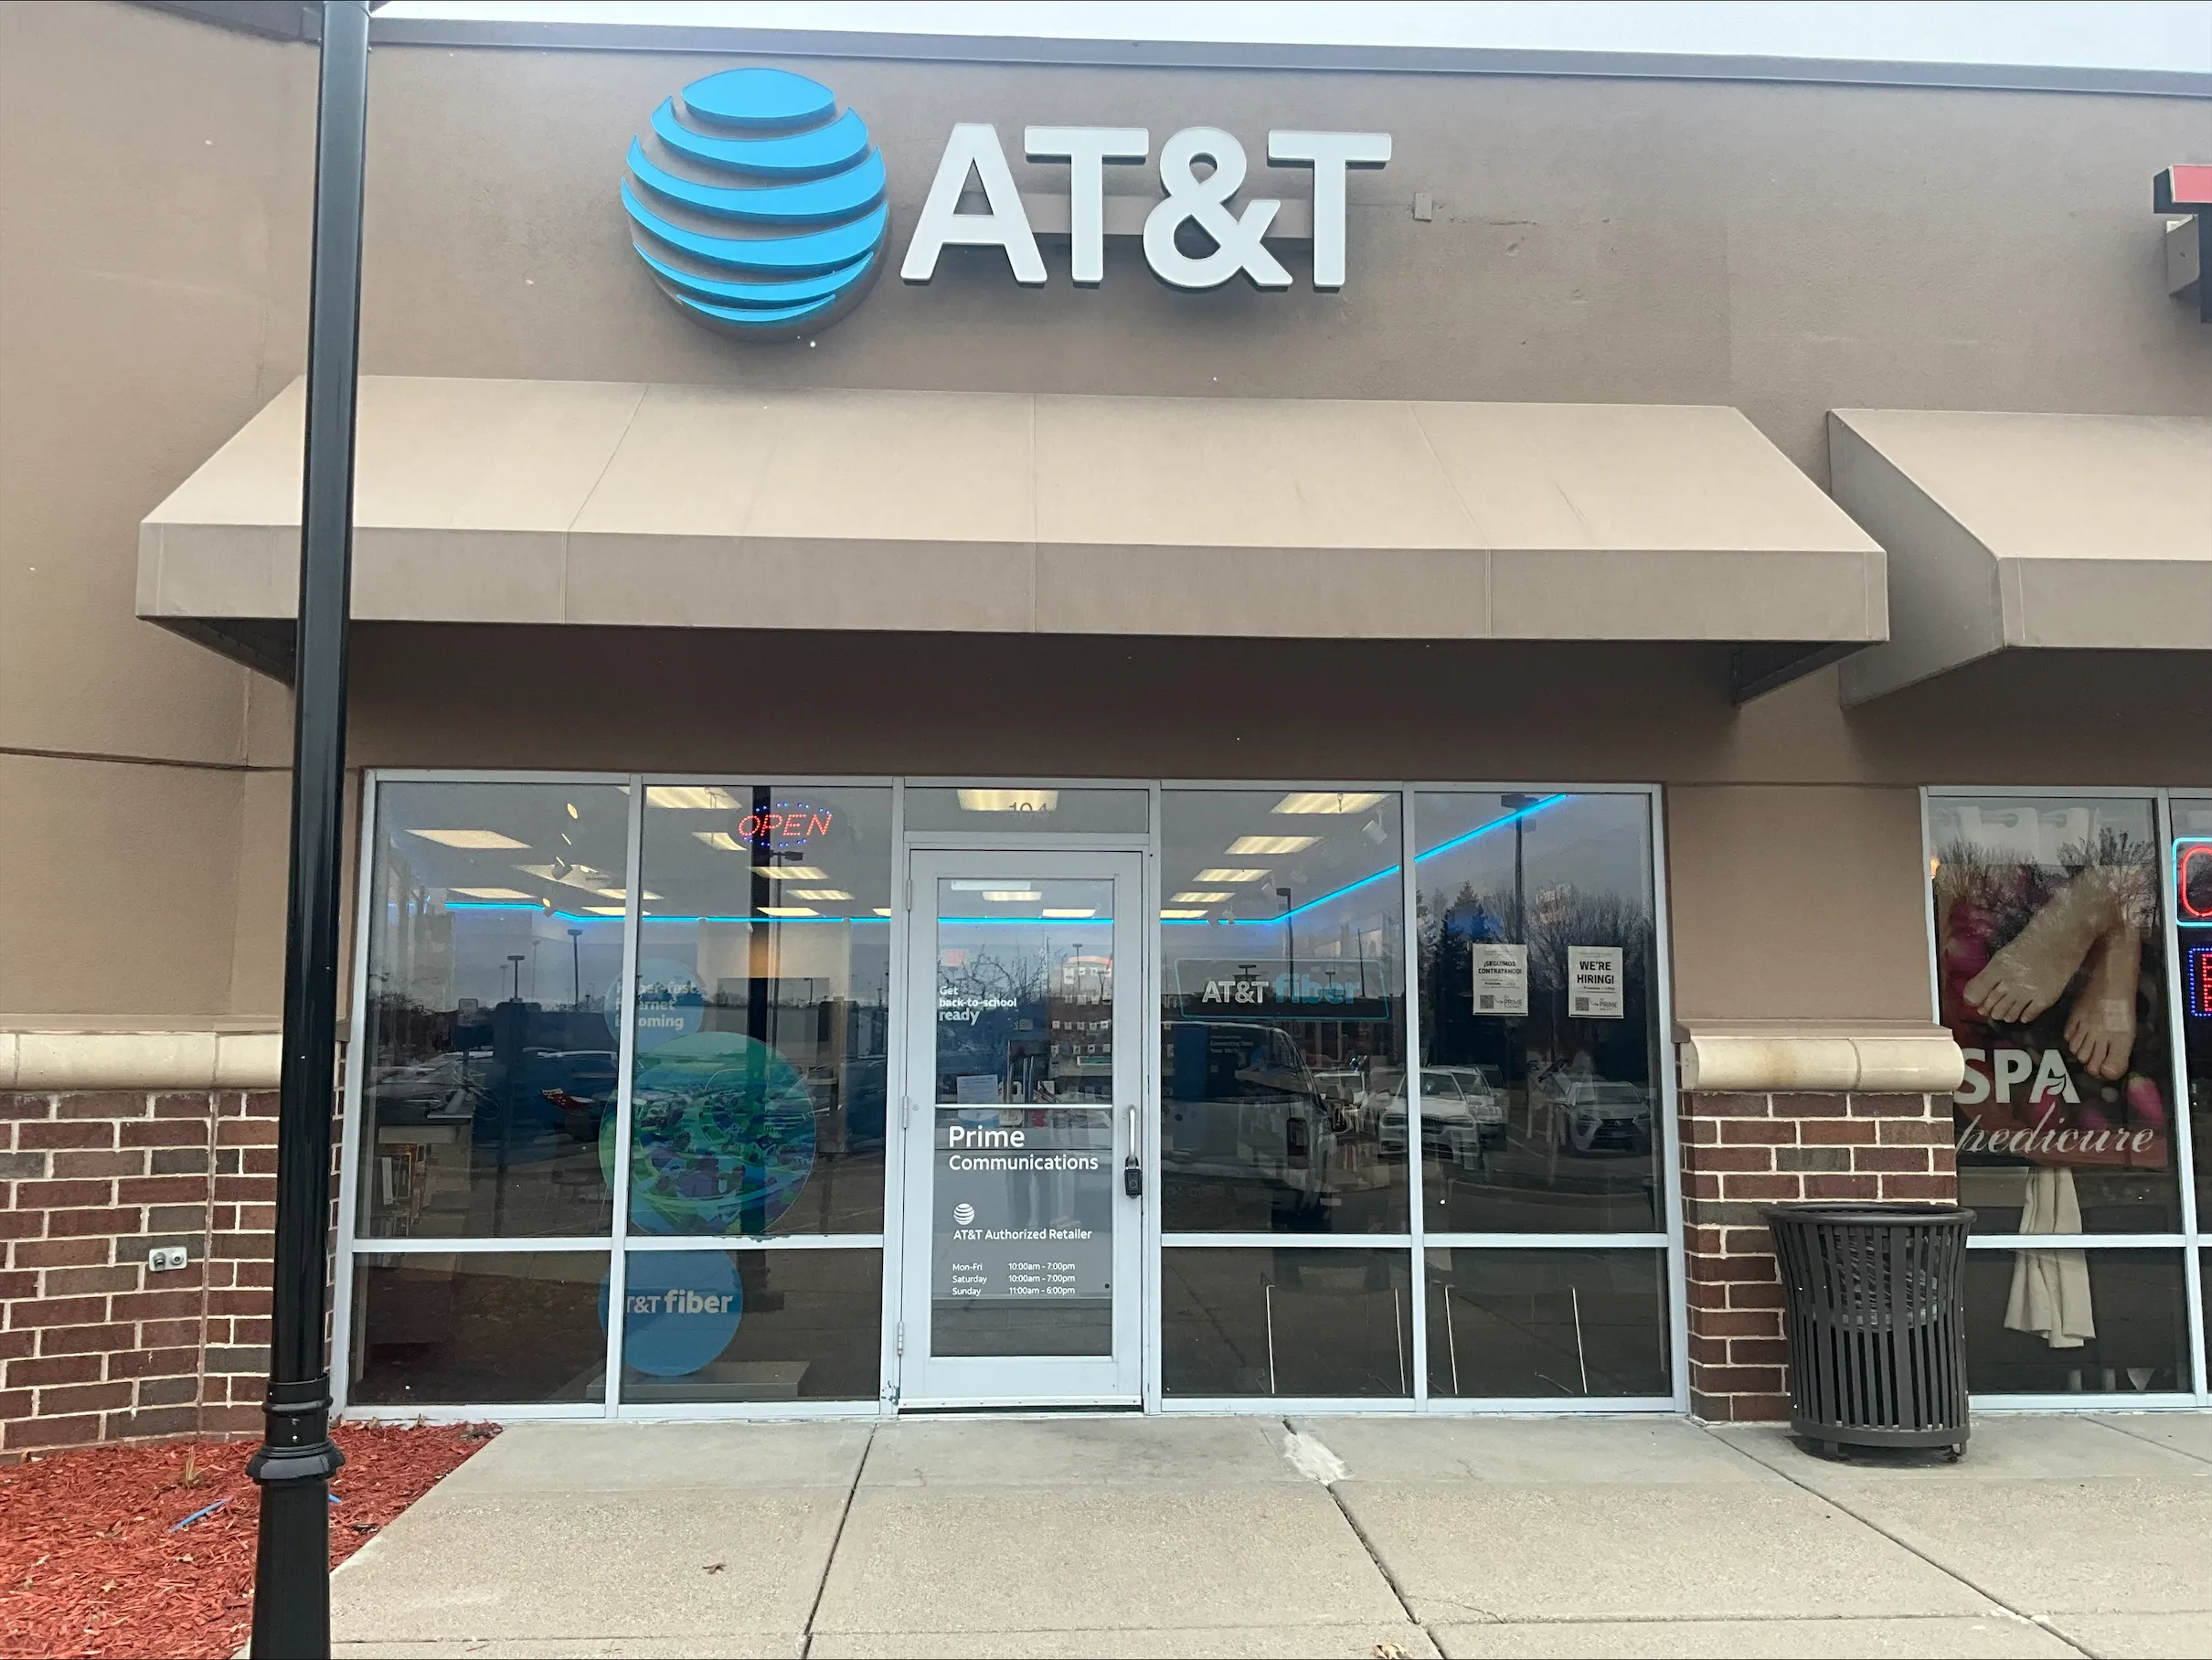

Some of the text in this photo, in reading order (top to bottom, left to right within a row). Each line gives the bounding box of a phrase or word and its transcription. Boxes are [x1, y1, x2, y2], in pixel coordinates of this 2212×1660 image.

[900, 122, 1392, 288] AT&T
[738, 814, 833, 836] OPEN
[1579, 961, 1611, 971] WE'RE
[1577, 974, 1614, 984] HIRING!
[939, 985, 959, 995] Get
[1202, 973, 1361, 1004] AT&T fiber
[939, 996, 1017, 1008] back-to-school
[614, 1014, 684, 1030] ioming
[939, 1007, 981, 1026] ready
[1953, 1048, 2081, 1104] SPA
[949, 1124, 1025, 1148] Prime
[1955, 1101, 2154, 1155] pedicure
[949, 1154, 1099, 1171] Communications
[952, 1229, 1092, 1240] AT&T Authorized Retailer
[952, 1262, 983, 1271] Mon-Fri
[1008, 1262, 1040, 1271] 10:00am
[1047, 1262, 1076, 1272] 7:00pm
[952, 1275, 988, 1284] Saturday
[1008, 1274, 1040, 1282] 10:00am
[1047, 1274, 1076, 1284] 7:00pm
[952, 1287, 982, 1296] Sunday
[1047, 1287, 1076, 1295] 6:00pm
[627, 1289, 734, 1314] T&T fiber
